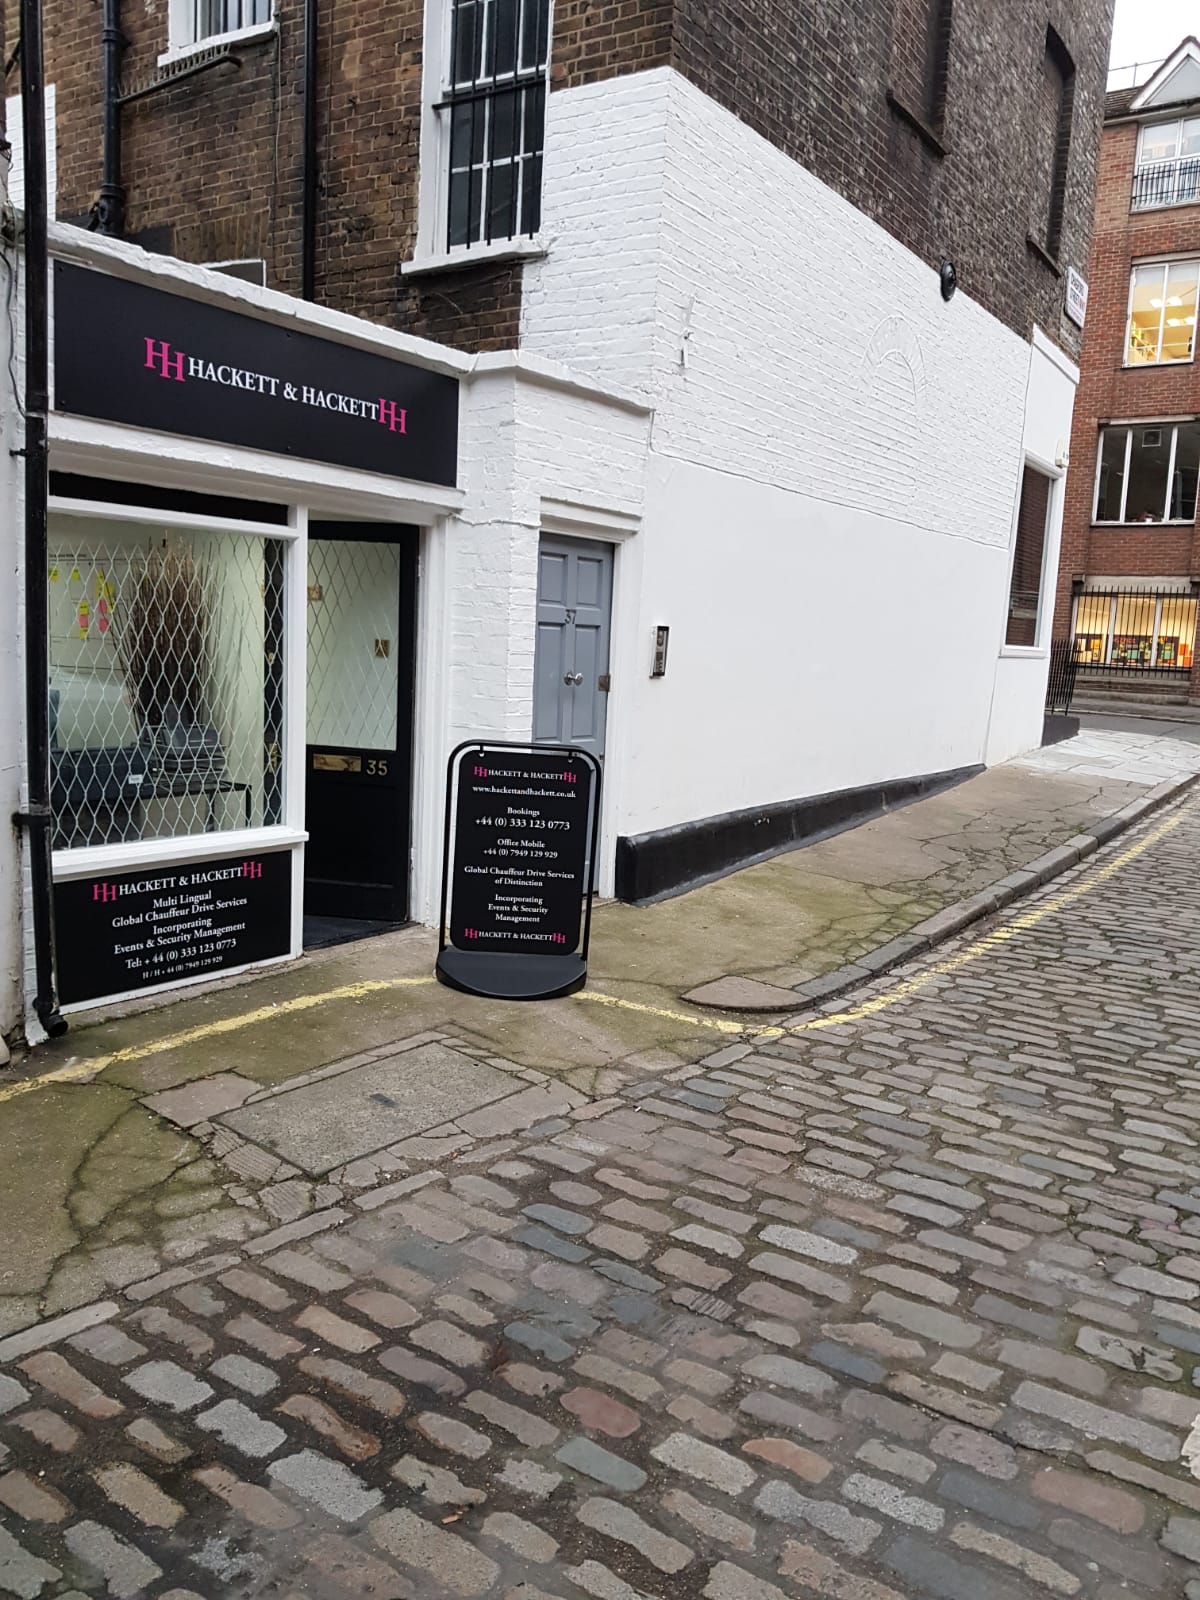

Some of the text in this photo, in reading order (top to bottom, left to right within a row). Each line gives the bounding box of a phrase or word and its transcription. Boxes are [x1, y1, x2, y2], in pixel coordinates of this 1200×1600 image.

[188, 356, 279, 396] HACKETT
[283, 382, 298, 401] &
[302, 385, 379, 421] HACKETT
[564, 609, 577, 624] 37
[366, 760, 388, 776] 35
[488, 769, 522, 778] HACKETT
[530, 772, 564, 780] HACKETT
[472, 786, 576, 798] www.hackettandhackett.co.uk
[507, 807, 540, 817] Bookings
[475, 816, 571, 830] +44 (0) 333 123 0773
[497, 838, 545, 848] Office Mobile
[498, 848, 509, 856] (0)
[510, 849, 528, 857] 7949
[530, 850, 543, 858] 129
[544, 851, 558, 859] 929
[464, 865, 575, 879] Global Chauffeur Drive Services
[119, 877, 176, 896] HACKETT
[179, 876, 189, 886] &
[191, 867, 243, 884] HACKETT
[494, 877, 543, 887] of Distinction
[153, 889, 212, 909] Multi Lingual
[495, 894, 543, 905] Incorporating
[112, 897, 248, 928] Global Chauffeur Drive Services
[488, 903, 511, 912] Events
[520, 905, 549, 915] Security
[495, 913, 540, 923] Management
[153, 917, 213, 935] Incorporating
[114, 922, 246, 955] Events & Security Management
[478, 931, 512, 939] HACKETT
[520, 933, 553, 941] HACKETT
[125, 957, 142, 969] Tel:
[152, 952, 164, 963] 44
[166, 949, 178, 962] (0)
[180, 946, 197, 958] 333
[199, 942, 214, 954] 123
[216, 938, 237, 951] 0773
[175, 963, 184, 972] (0)
[201, 957, 212, 967] 129
